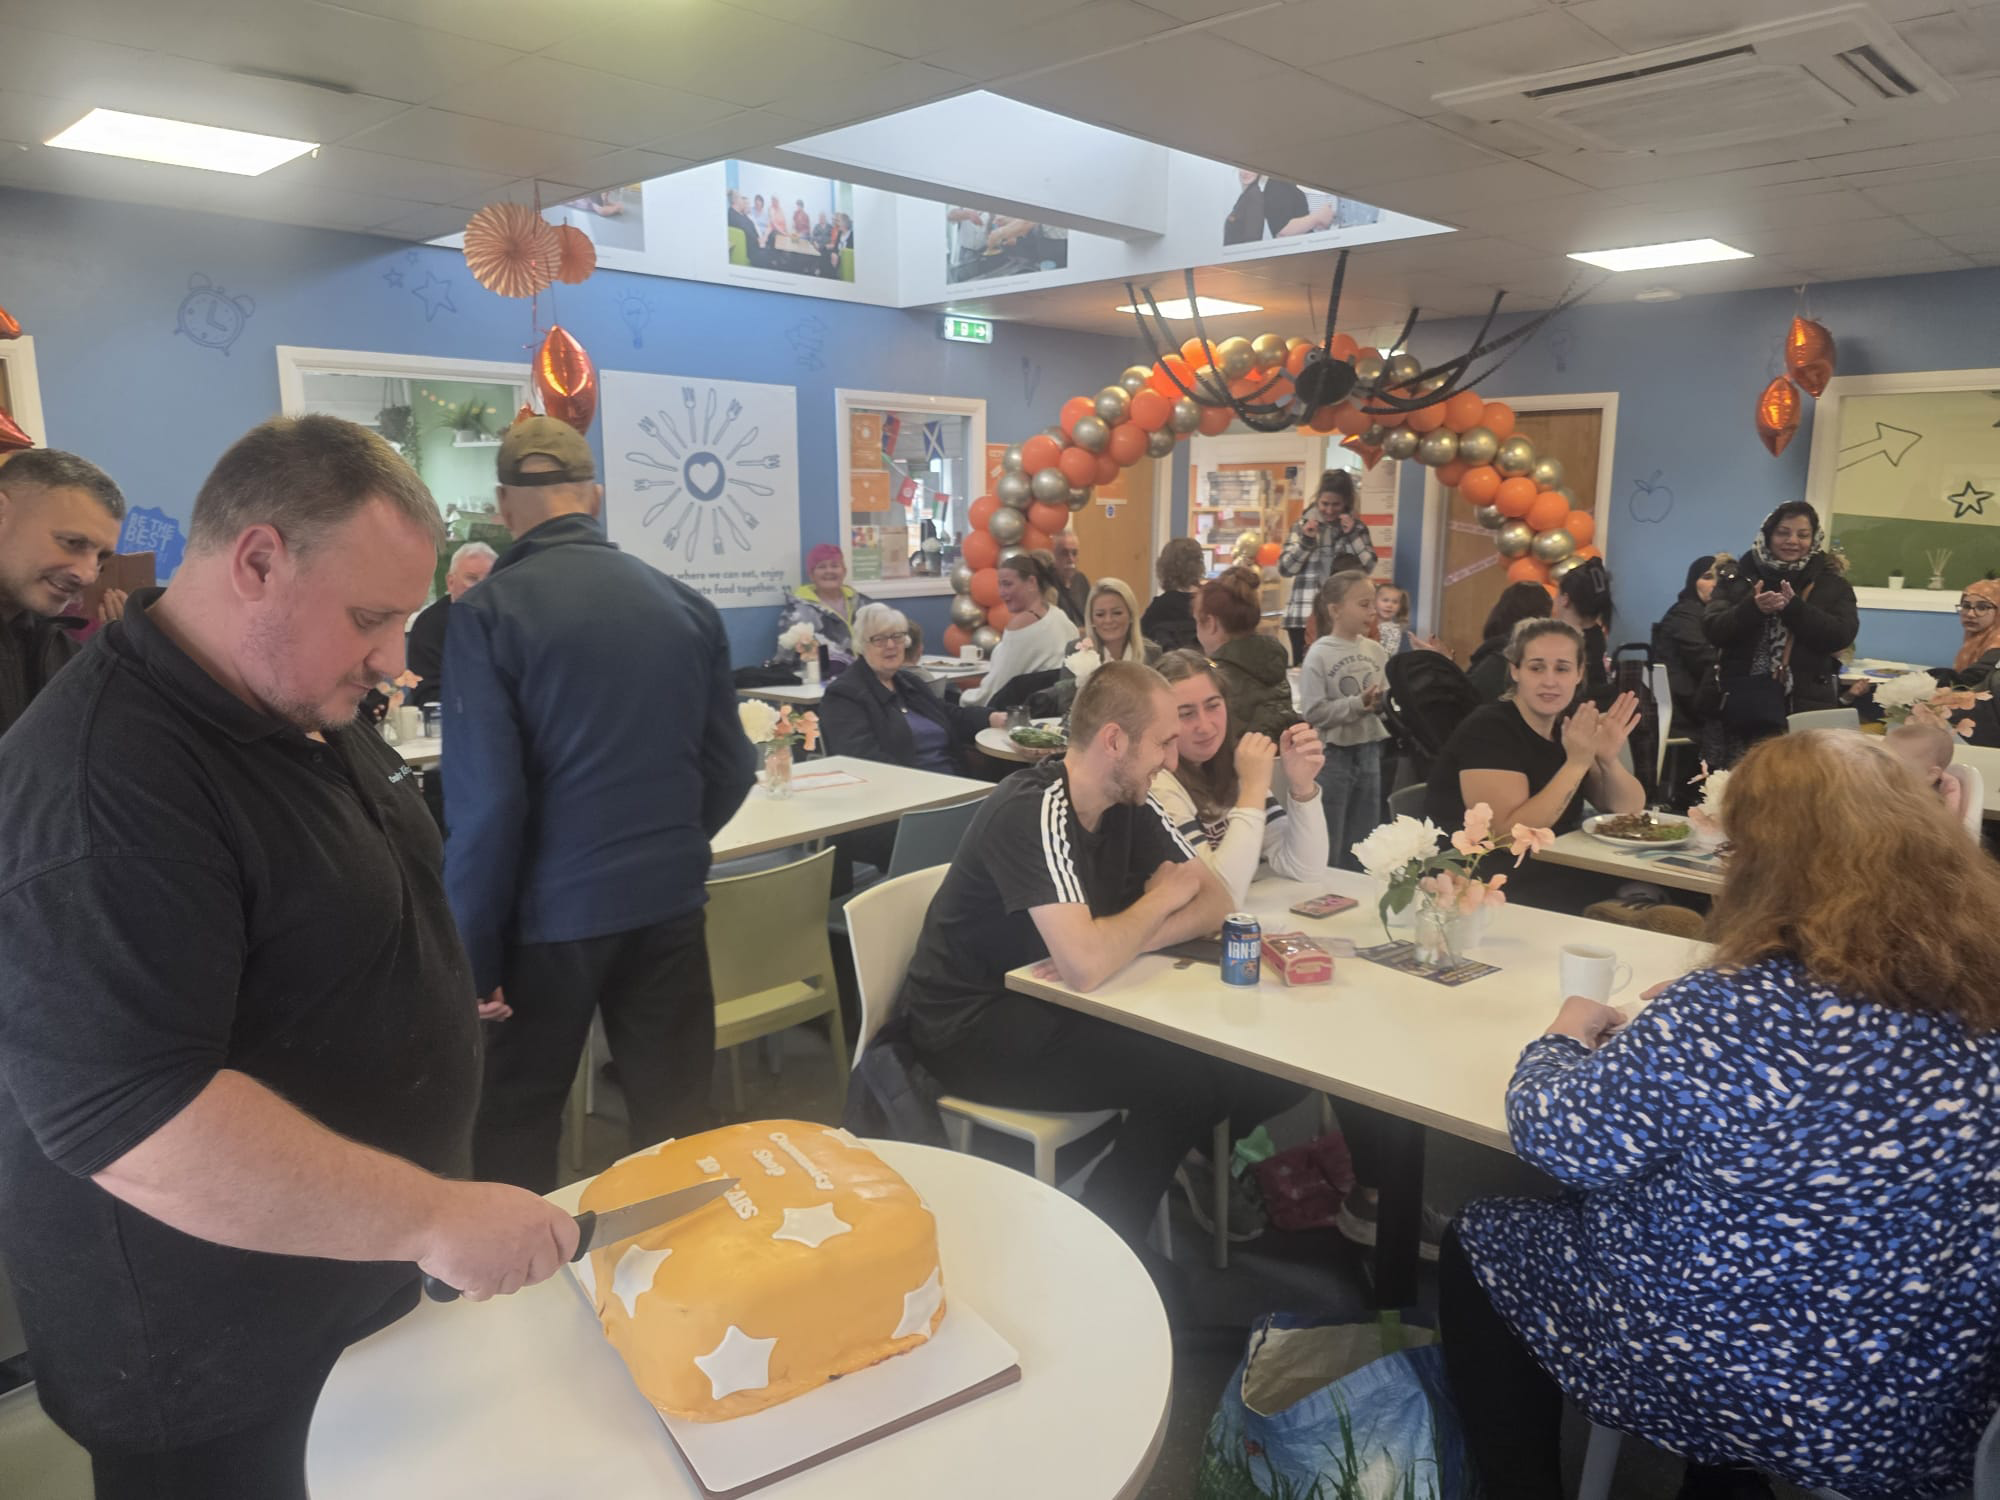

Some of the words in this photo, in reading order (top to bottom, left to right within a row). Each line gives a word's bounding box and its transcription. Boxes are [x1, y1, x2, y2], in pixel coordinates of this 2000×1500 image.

[129, 512, 148, 528] BE
[151, 518, 176, 539] THE
[126, 526, 170, 551] BEST
[723, 571, 738, 579] can
[714, 583, 735, 594] food
[1327, 655, 1356, 678] MONTE
